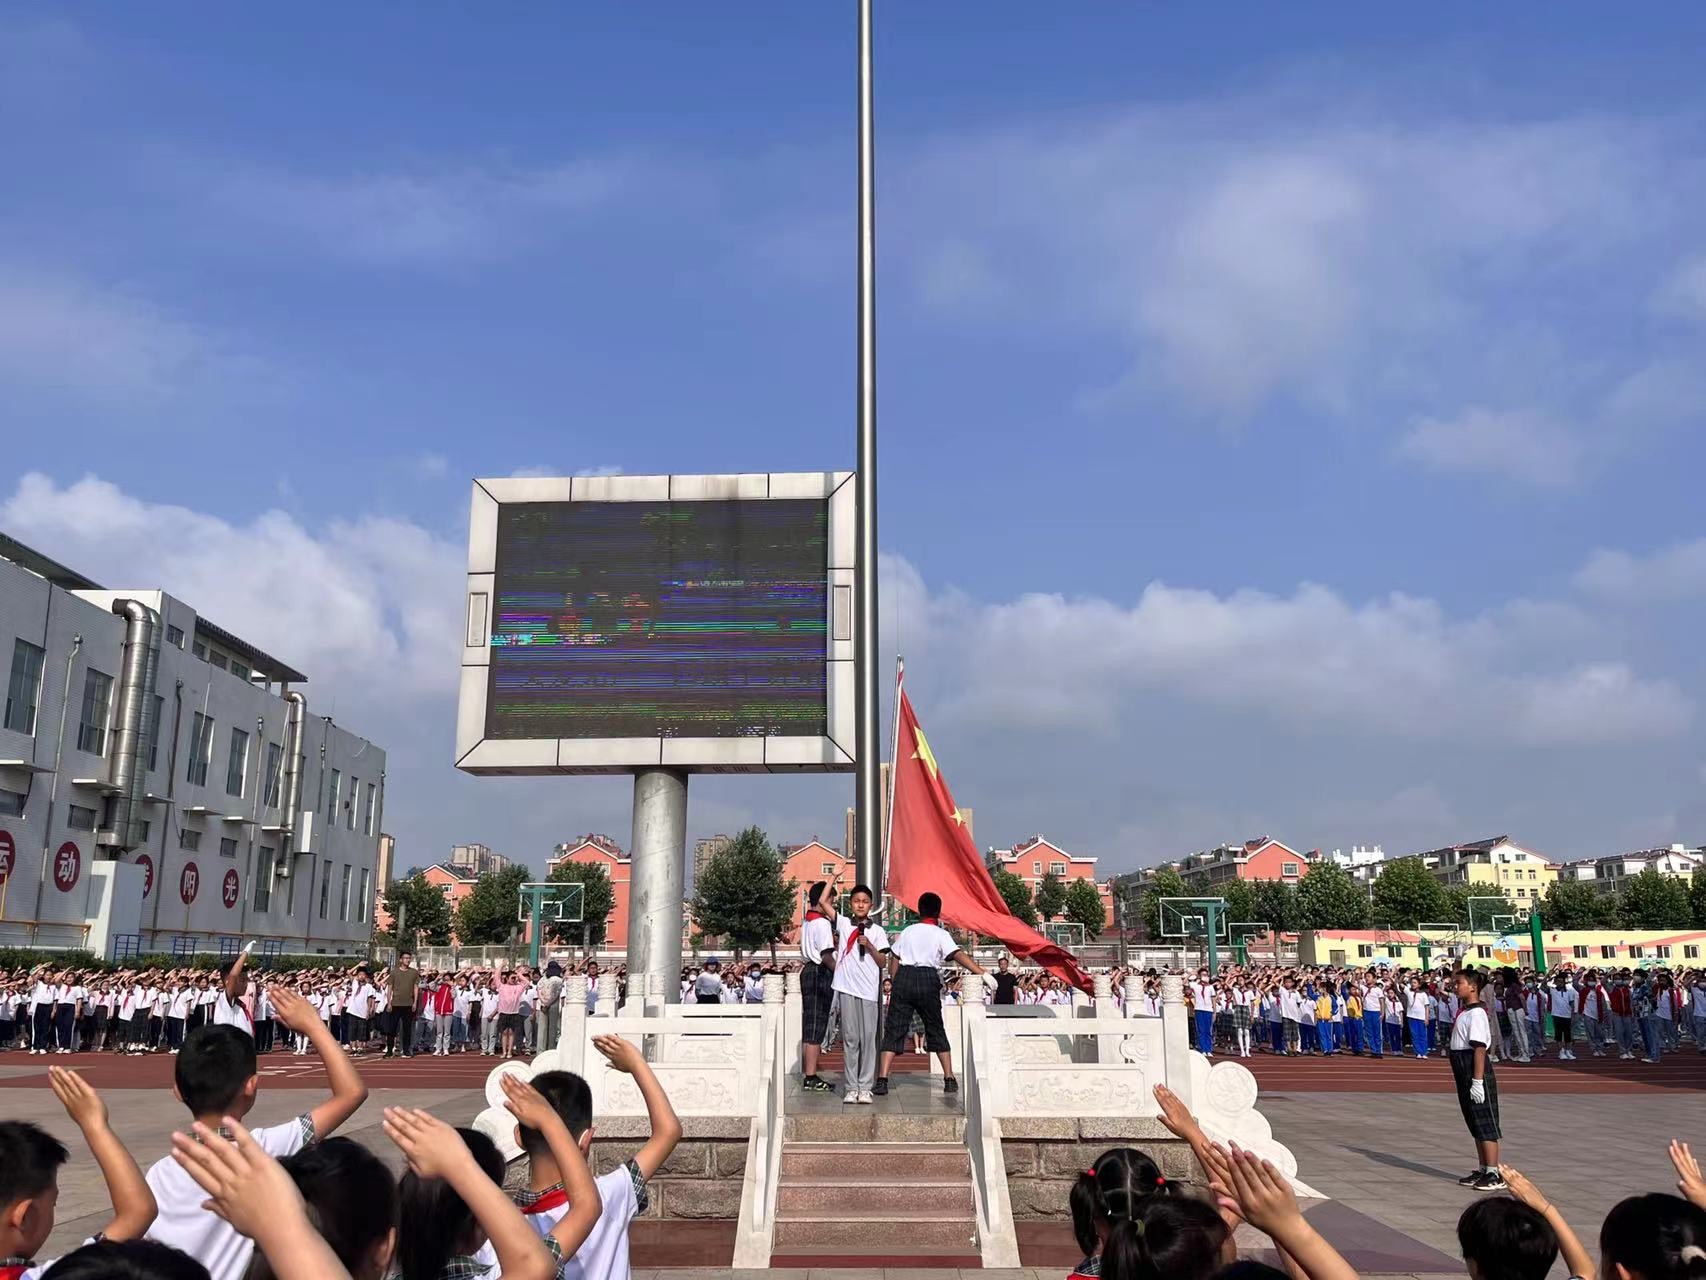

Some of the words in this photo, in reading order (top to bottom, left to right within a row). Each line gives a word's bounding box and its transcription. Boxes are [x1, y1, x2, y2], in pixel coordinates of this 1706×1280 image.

[58, 851, 77, 882] 动
[183, 870, 197, 896] 阳
[225, 876, 237, 901] 光
